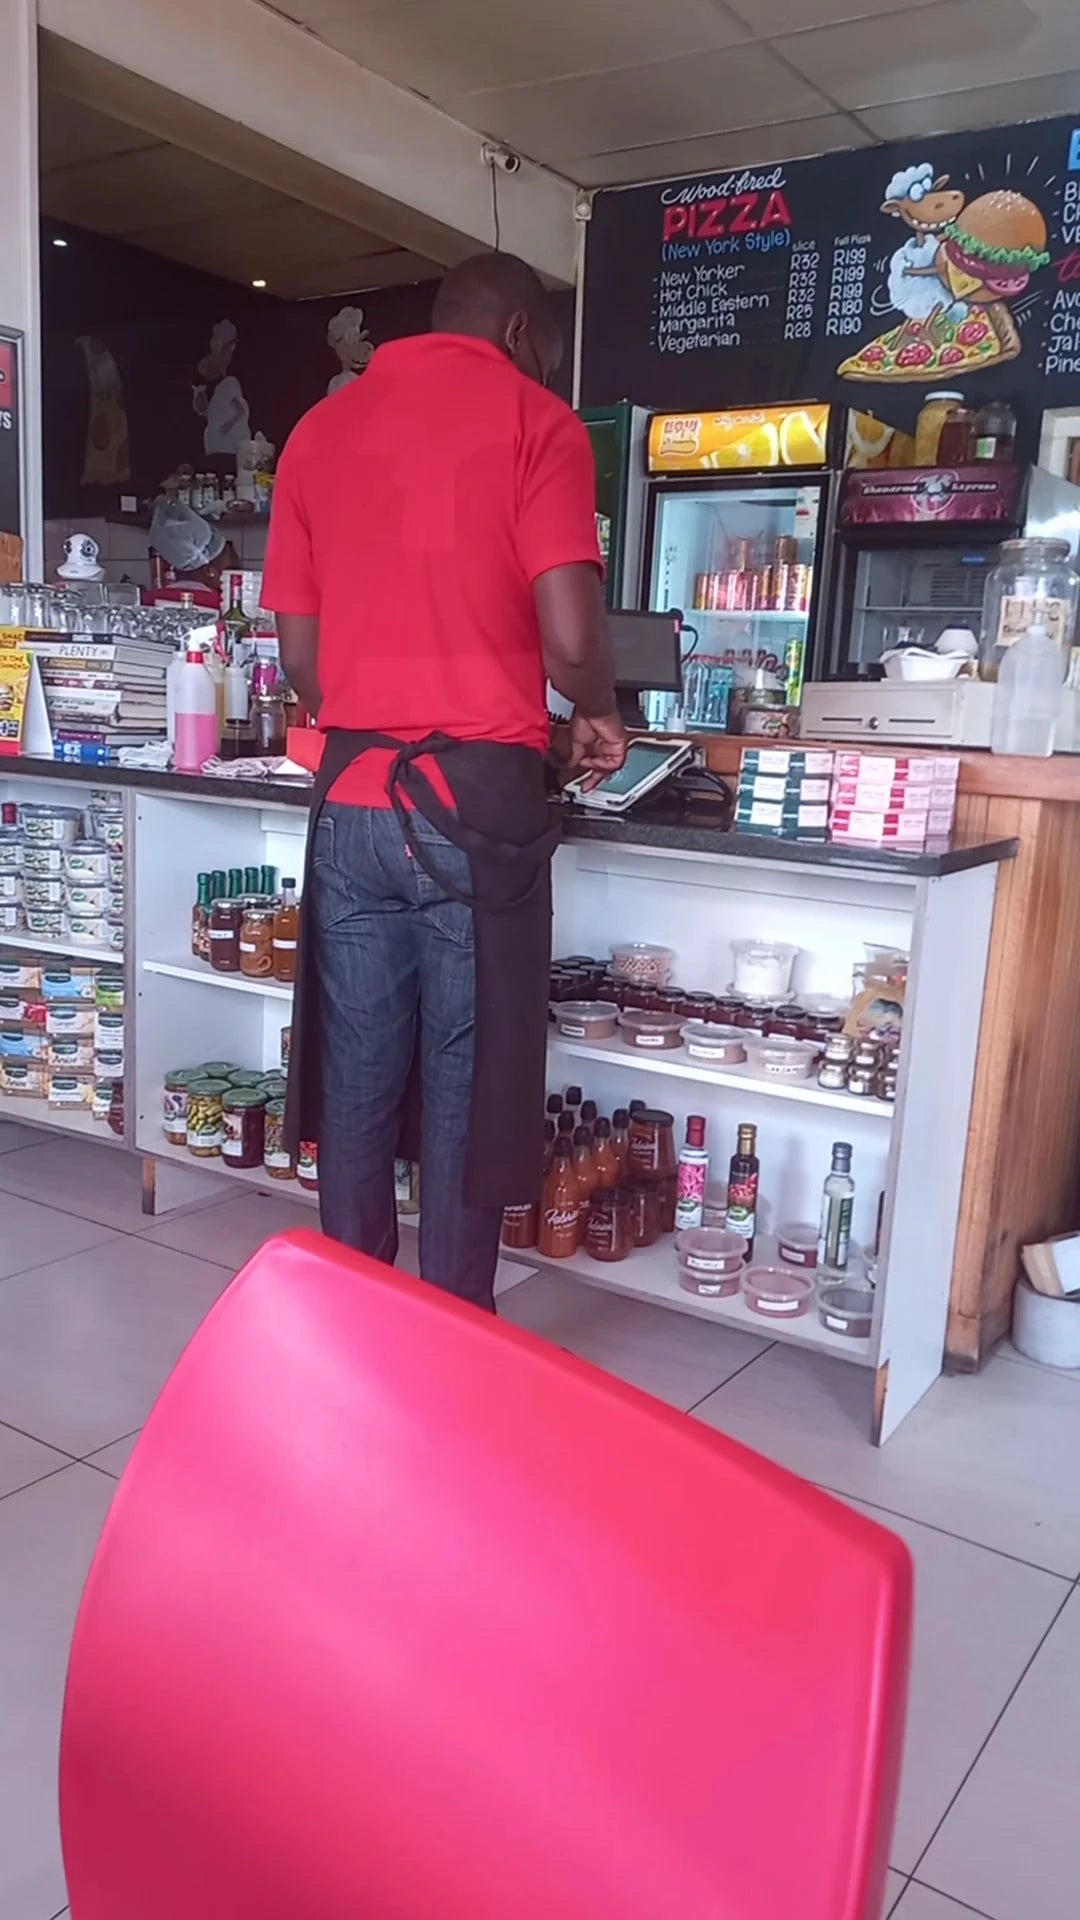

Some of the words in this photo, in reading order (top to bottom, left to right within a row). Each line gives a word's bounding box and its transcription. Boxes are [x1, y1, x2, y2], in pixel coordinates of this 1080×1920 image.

[662, 189, 792, 243] PIZZA
[661, 242, 701, 262] (New
[705, 238, 740, 256] York
[744, 227, 791, 253] Style)
[790, 252, 820, 271] R32
[833, 247, 866, 266] R199
[659, 271, 691, 288] New
[693, 263, 745, 283] Yorker
[789, 270, 817, 289] R32
[831, 265, 865, 284] R199
[659, 287, 682, 304] Hot
[686, 280, 728, 300] Chick
[787, 287, 815, 304] R32
[829, 282, 864, 300] R199
[659, 301, 708, 319] Middle
[711, 294, 770, 314] Eastern
[785, 303, 813, 321] R25
[828, 299, 863, 317] R180
[659, 312, 736, 334] Margarita
[784, 321, 811, 340] R28
[825, 316, 862, 337] R190
[657, 332, 741, 354] Vegetarian
[58, 644, 98, 657] PLENTY
